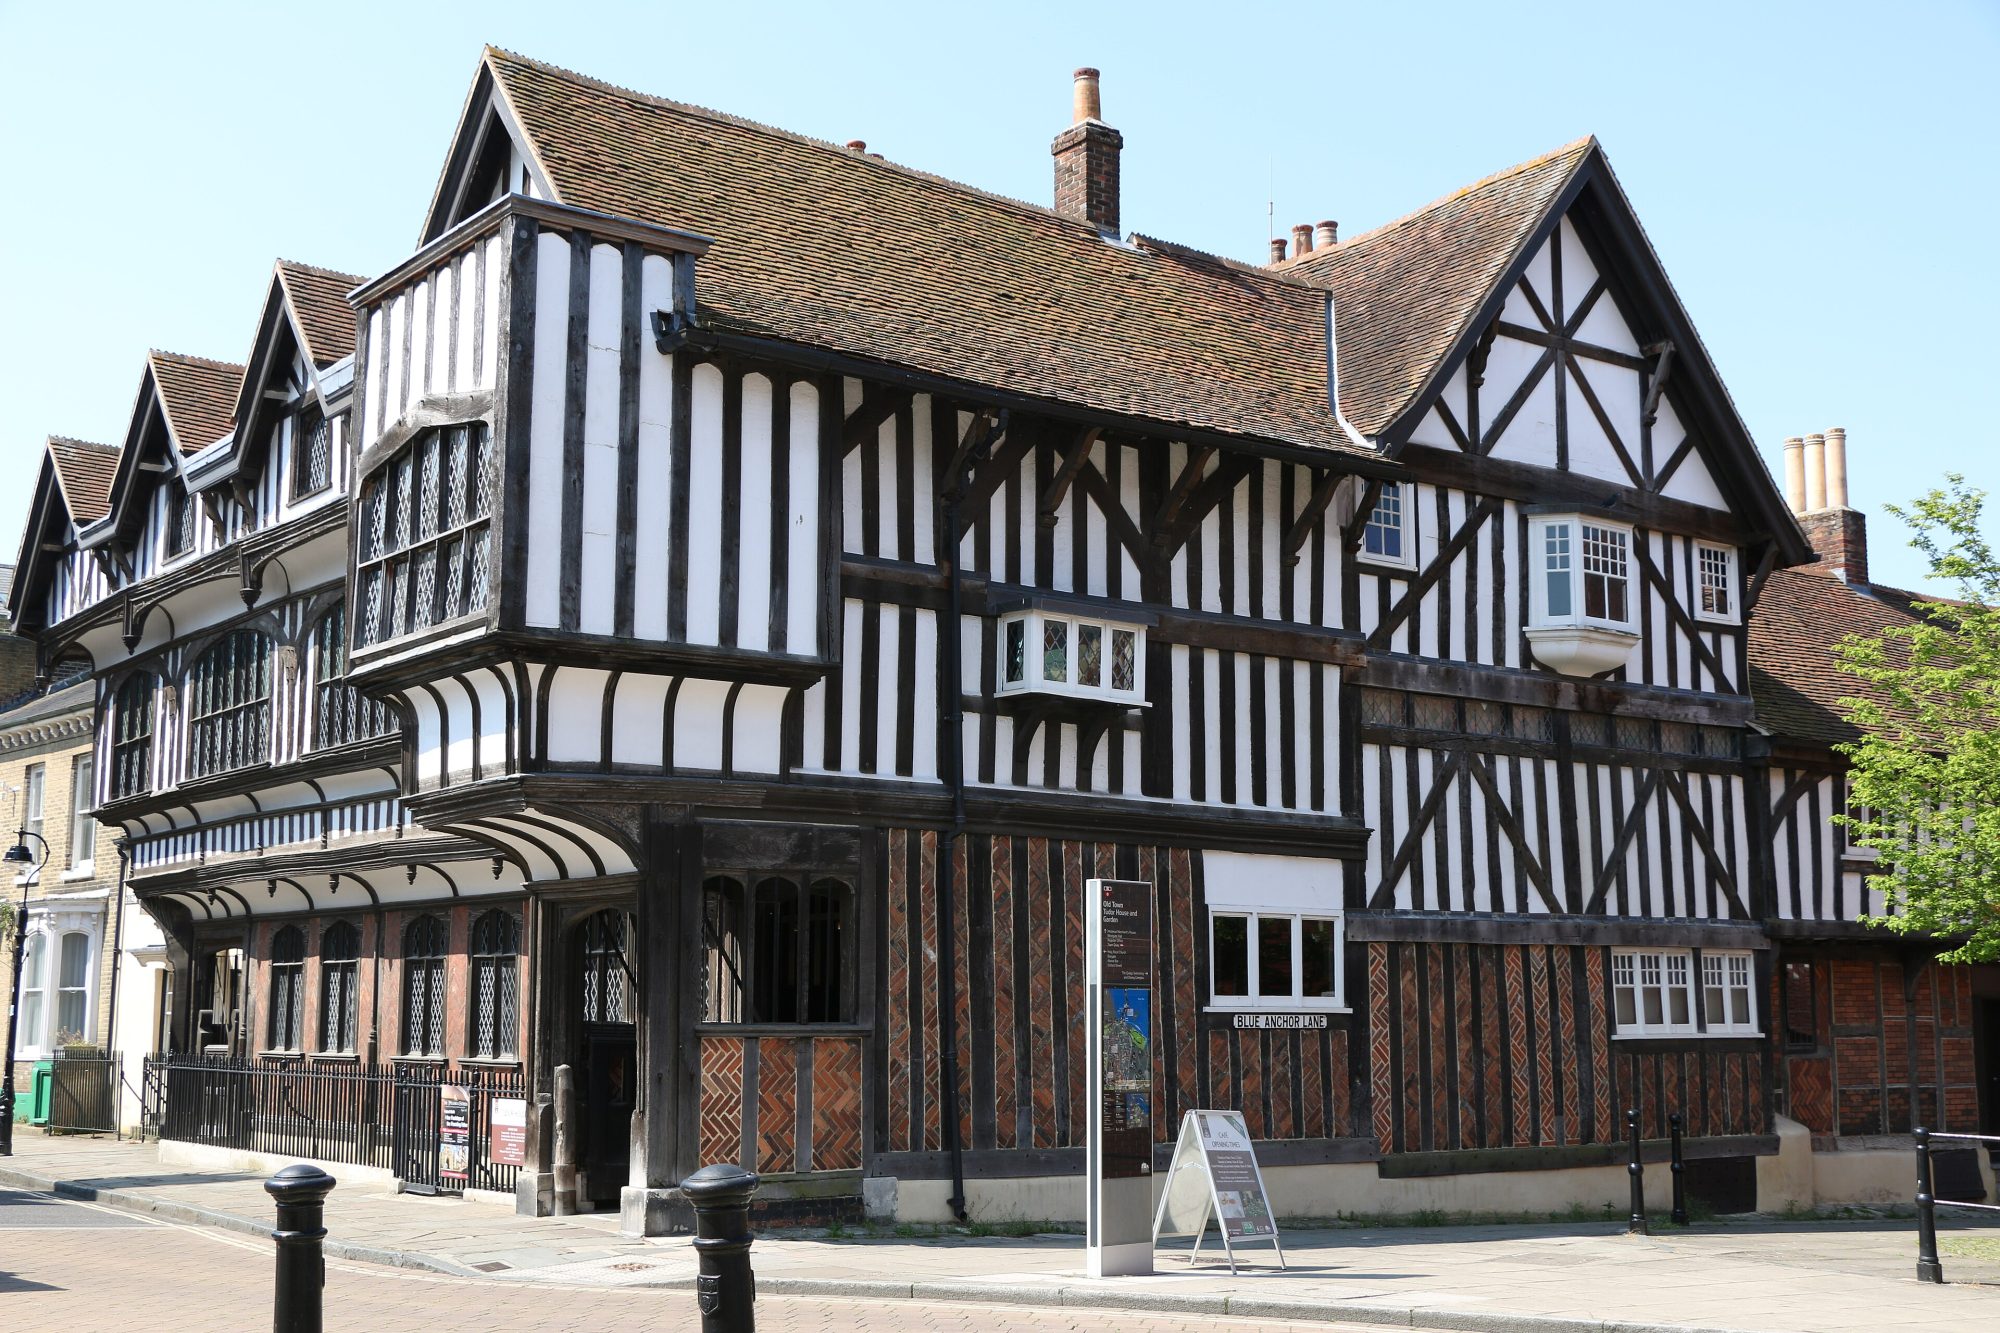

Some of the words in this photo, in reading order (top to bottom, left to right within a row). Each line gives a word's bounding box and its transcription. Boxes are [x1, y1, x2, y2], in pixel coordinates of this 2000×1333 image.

[1115, 909, 1130, 917] House
[1237, 1016, 1260, 1028] BLUE
[1264, 1016, 1300, 1028] ANCHOR
[1303, 1016, 1325, 1028] LANE
